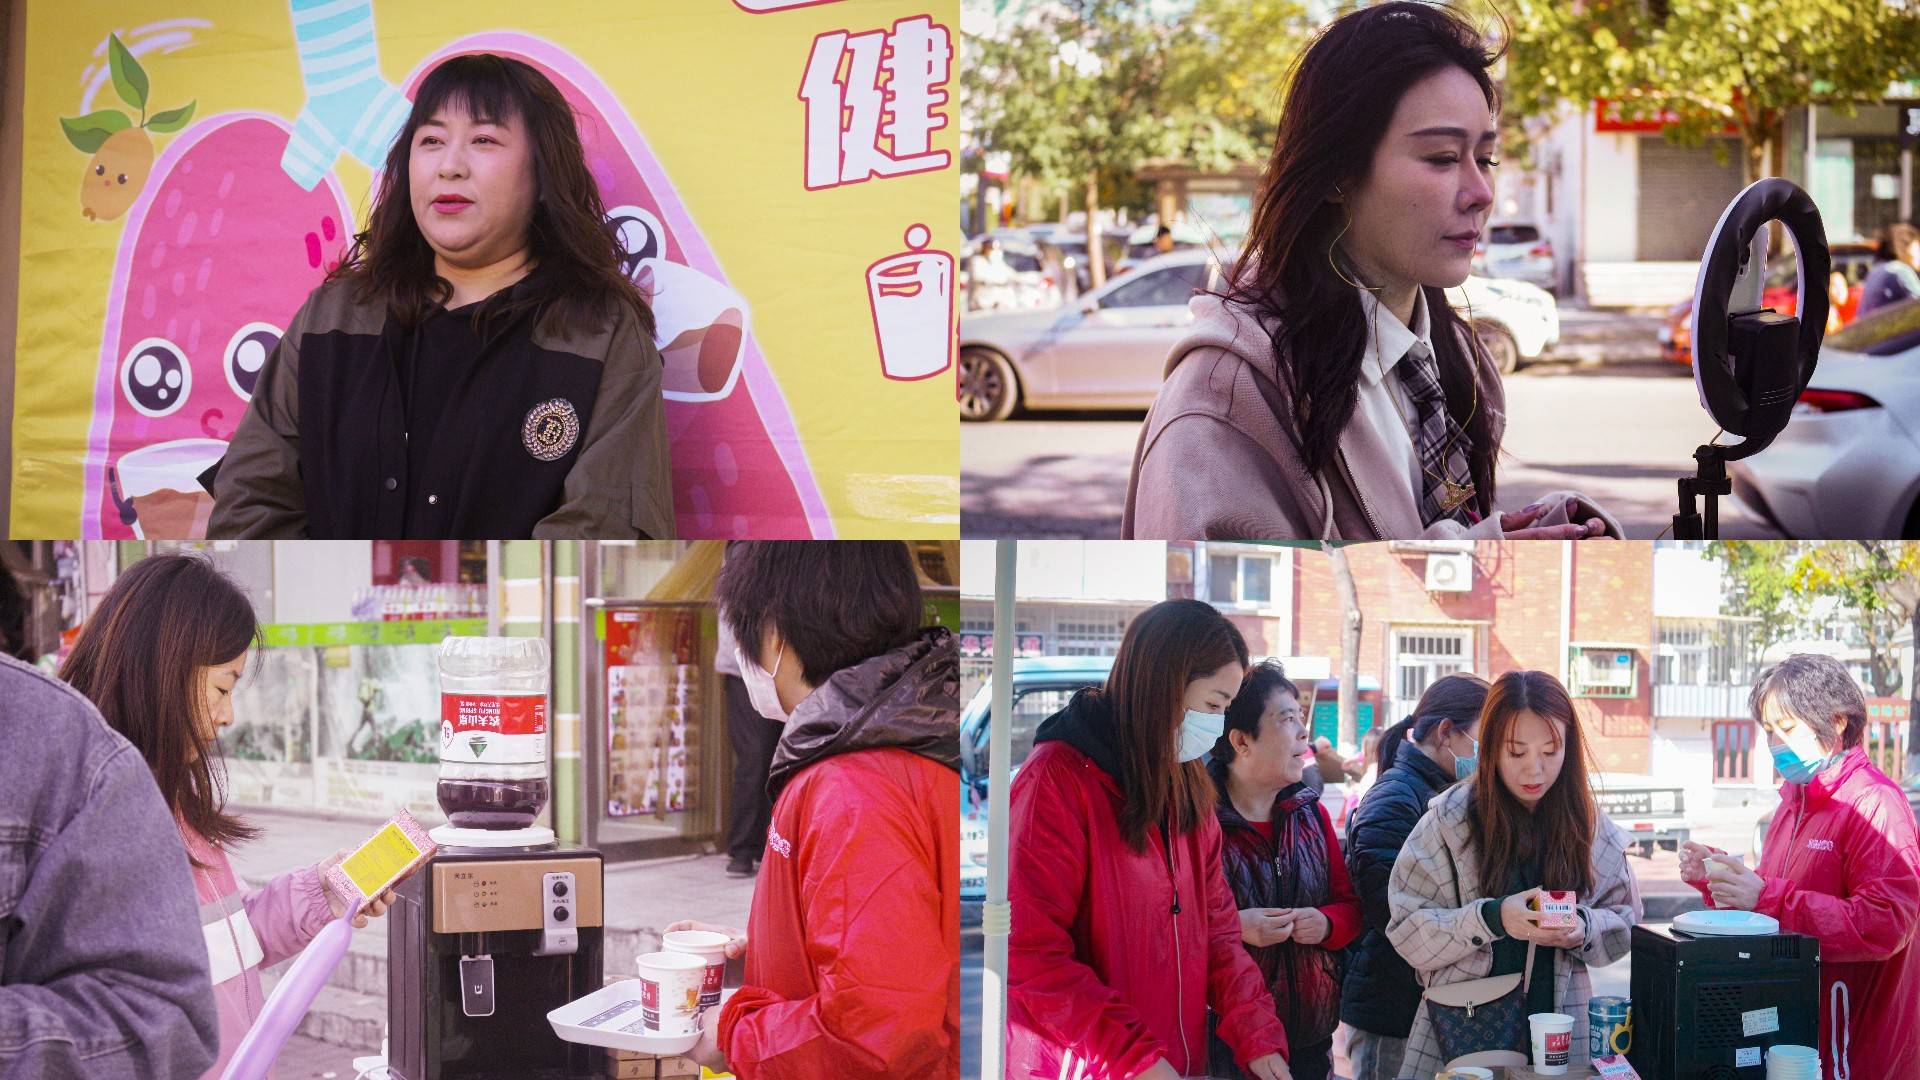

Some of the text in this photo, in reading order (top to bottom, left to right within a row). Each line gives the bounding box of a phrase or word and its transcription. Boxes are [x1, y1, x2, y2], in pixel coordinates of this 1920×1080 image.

[798, 13, 954, 191] 健
[458, 714, 500, 727] 农夫山泉
